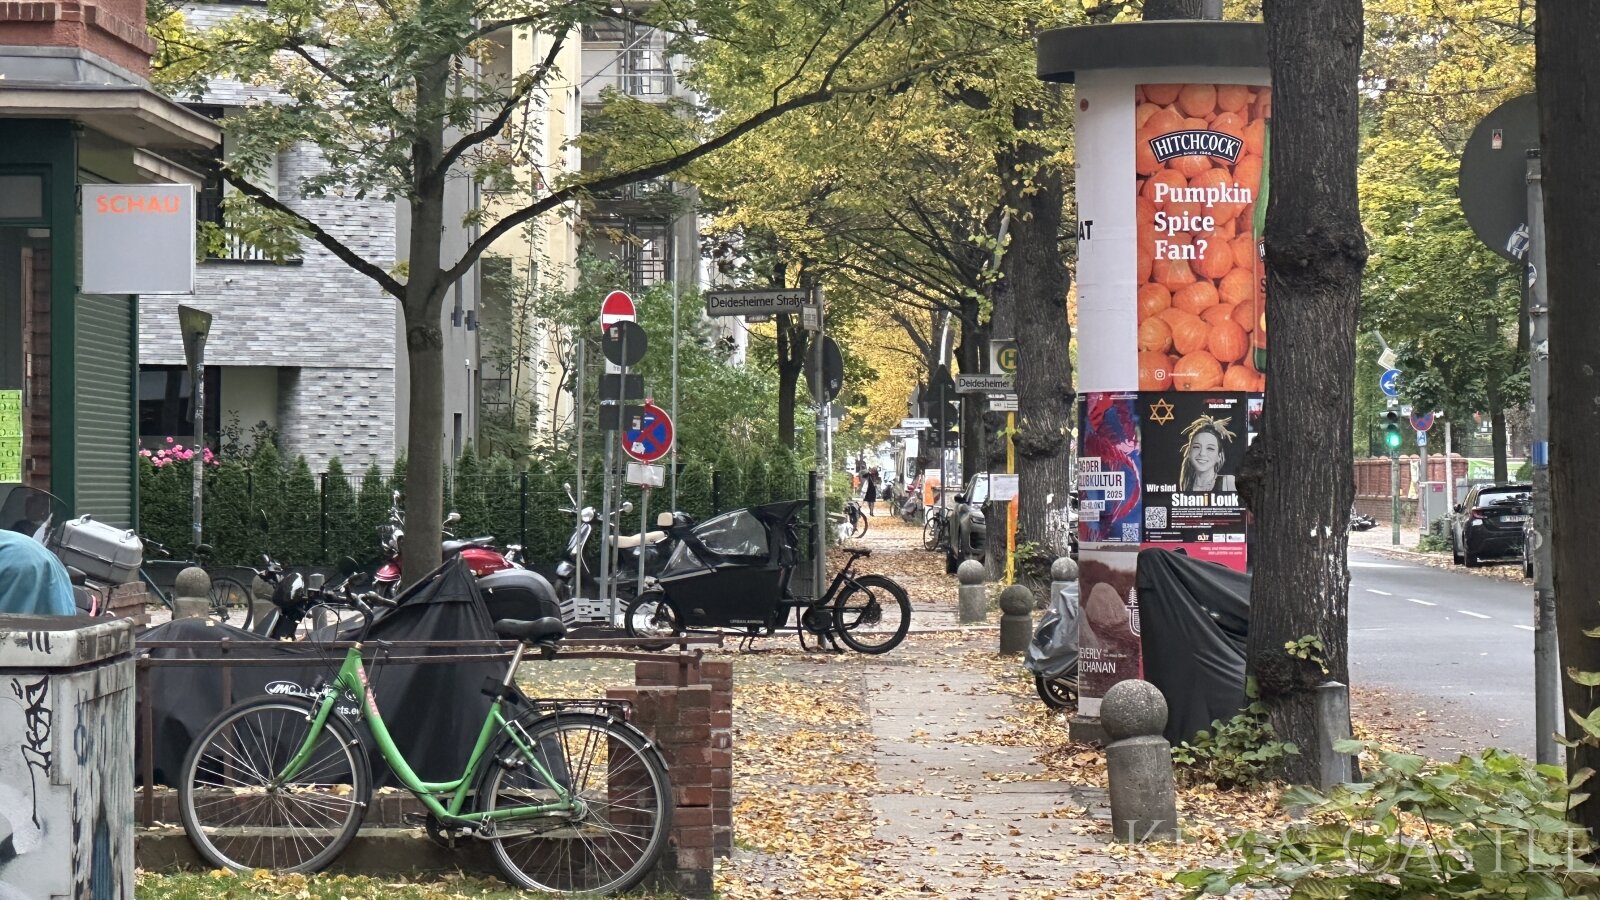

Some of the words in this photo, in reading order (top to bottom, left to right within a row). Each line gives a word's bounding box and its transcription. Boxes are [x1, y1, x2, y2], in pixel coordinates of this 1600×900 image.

[1155, 134, 1238, 157] HITCHCOCK
[1154, 182, 1252, 208] Pumpkin
[96, 194, 181, 214] SCHAU
[1154, 210, 1215, 237] Spice
[1154, 239, 1208, 260] Fan?
[711, 295, 774, 308] Deidesheimer
[776, 293, 805, 308] Straße
[959, 378, 1009, 388] Deidesheimer
[1086, 460, 1099, 473] DER
[1107, 490, 1123, 499] 2025
[1146, 483, 1159, 493] Wir
[1160, 483, 1177, 493] sind
[1171, 493, 1209, 507] Shani
[1210, 493, 1239, 507] Louk
[1079, 647, 1102, 659] EVERLY
[1079, 660, 1115, 673] UCHANAN
